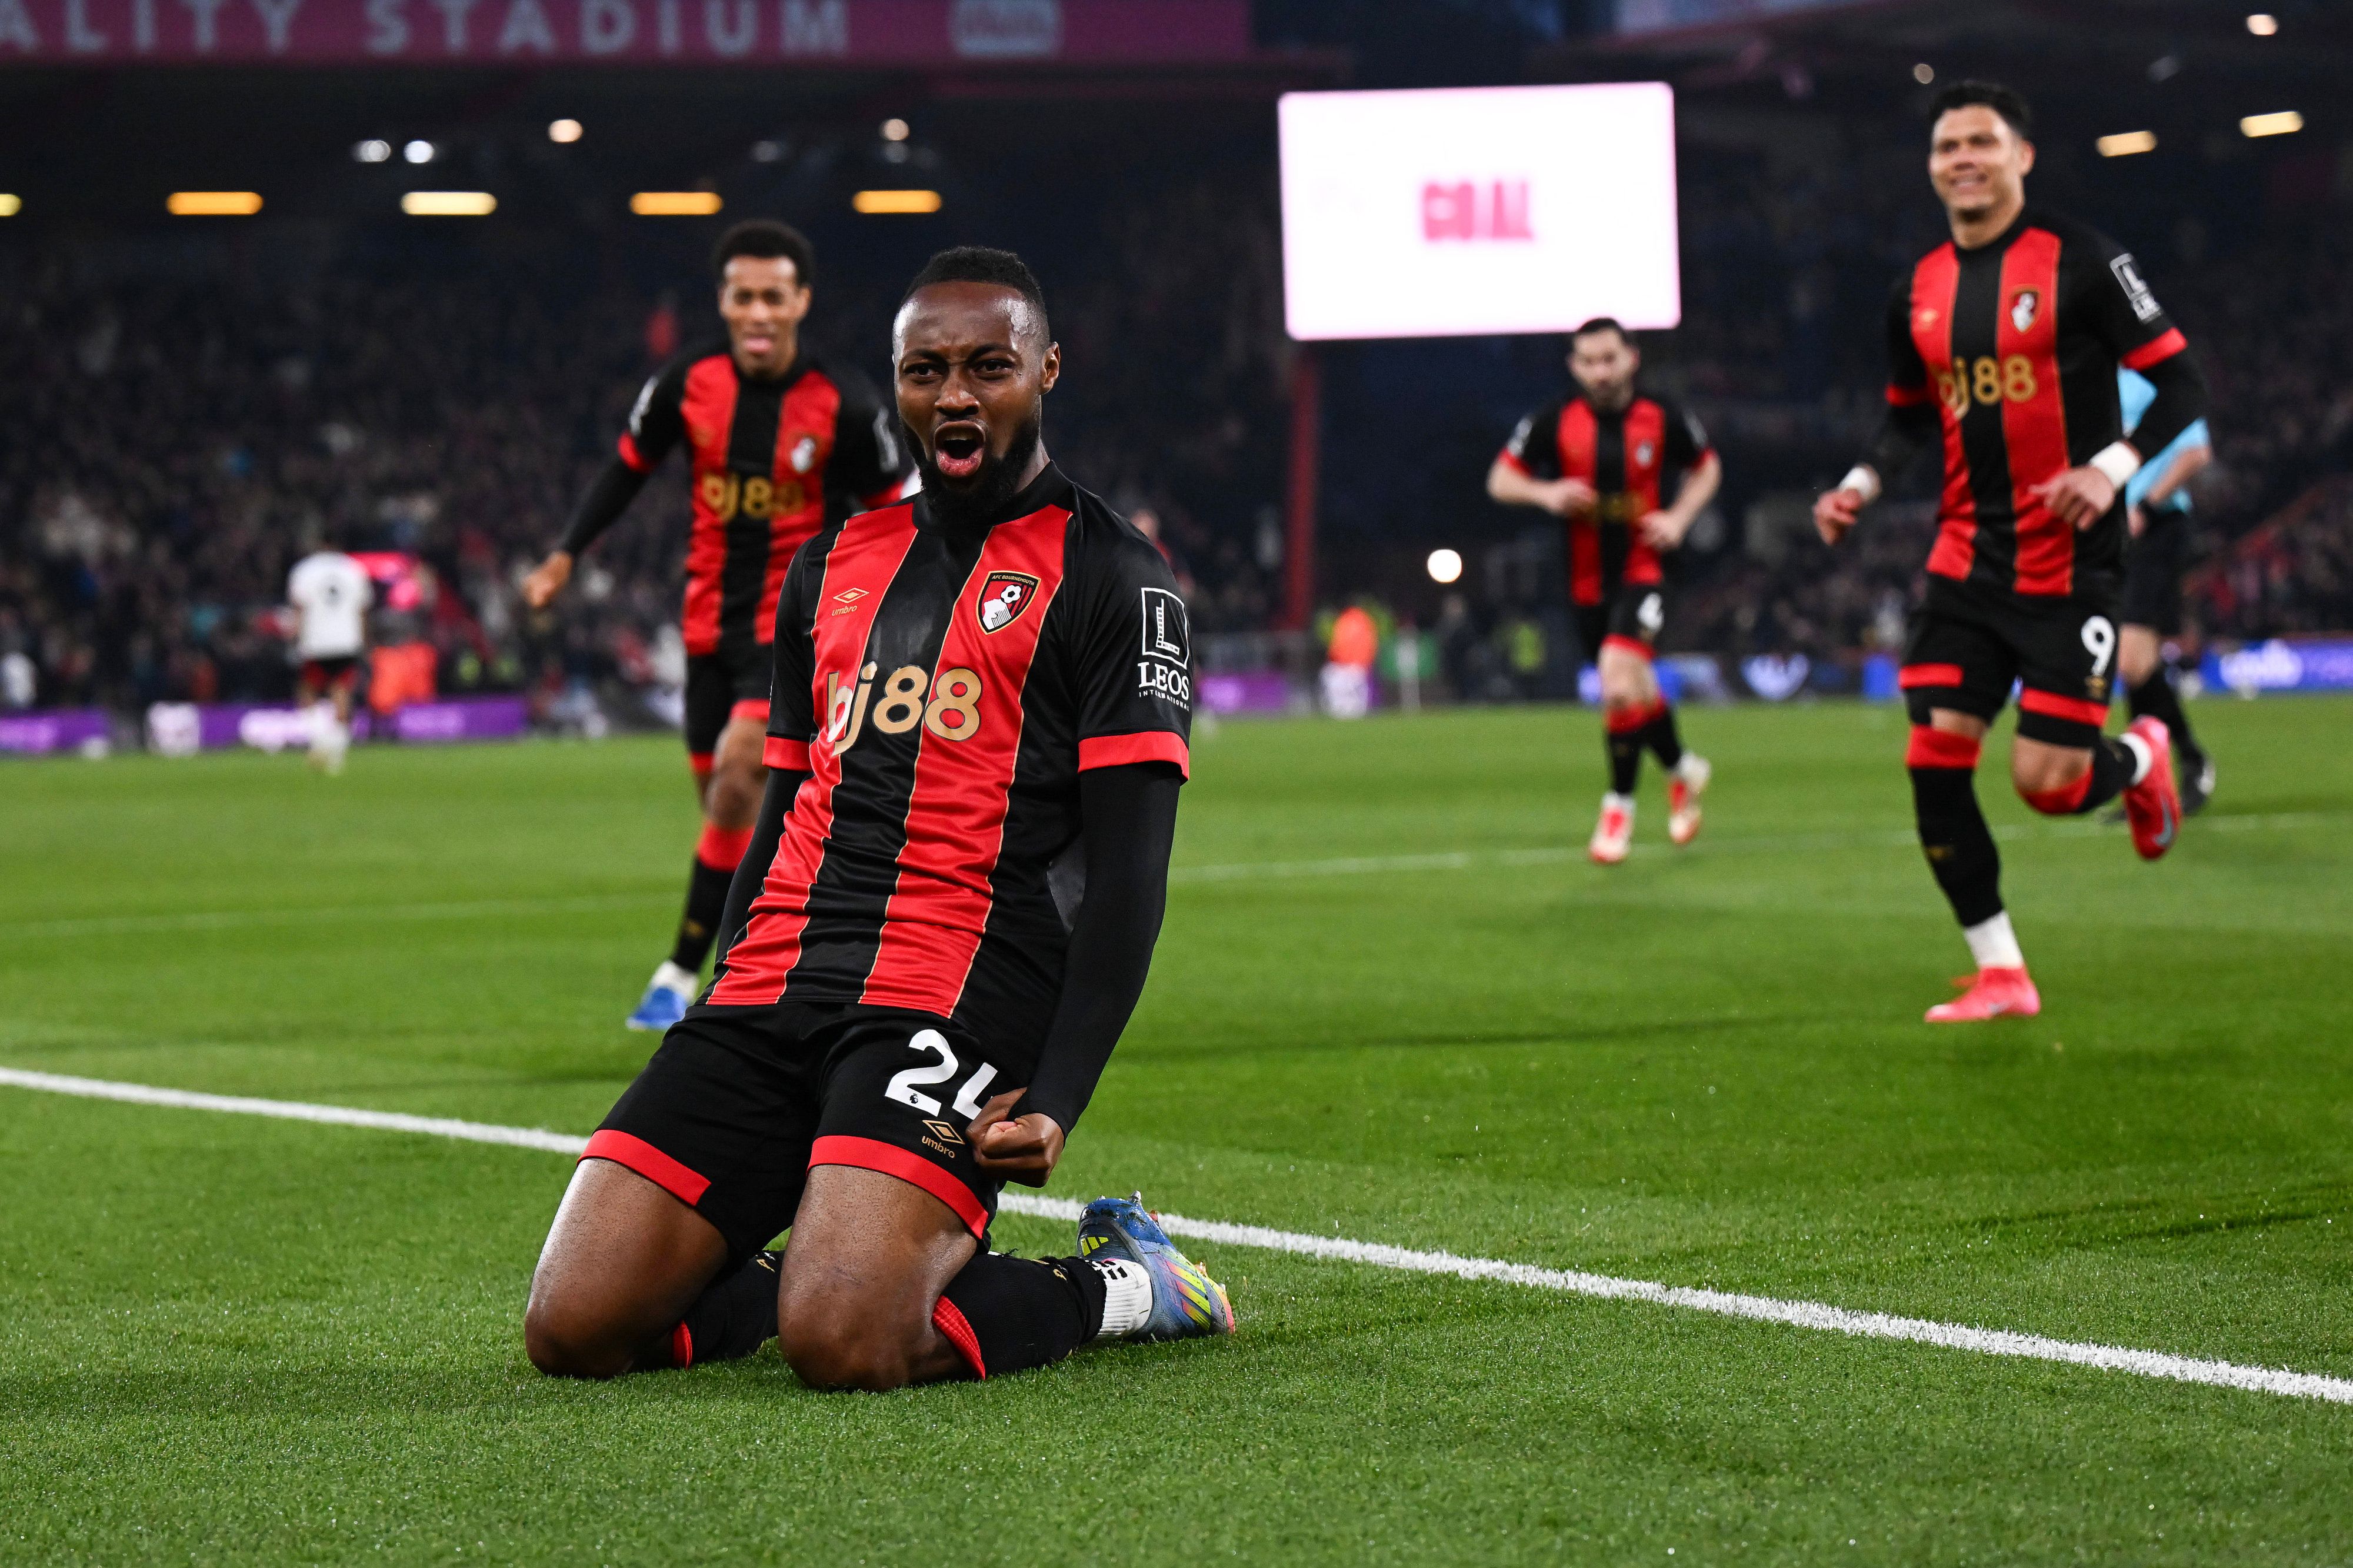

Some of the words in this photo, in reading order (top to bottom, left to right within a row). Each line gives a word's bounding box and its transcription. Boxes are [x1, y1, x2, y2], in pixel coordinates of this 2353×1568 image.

[366, 0, 848, 54] STADIUM
[1002, 575, 1035, 586] BOURNEMOUTH
[831, 605, 858, 616] umbro
[2081, 615, 2116, 676] 9
[1137, 661, 1189, 701] LEOS
[826, 660, 982, 758] bj88
[1139, 689, 1189, 712] INTERNATIONAL
[921, 1135, 956, 1159] umbro
